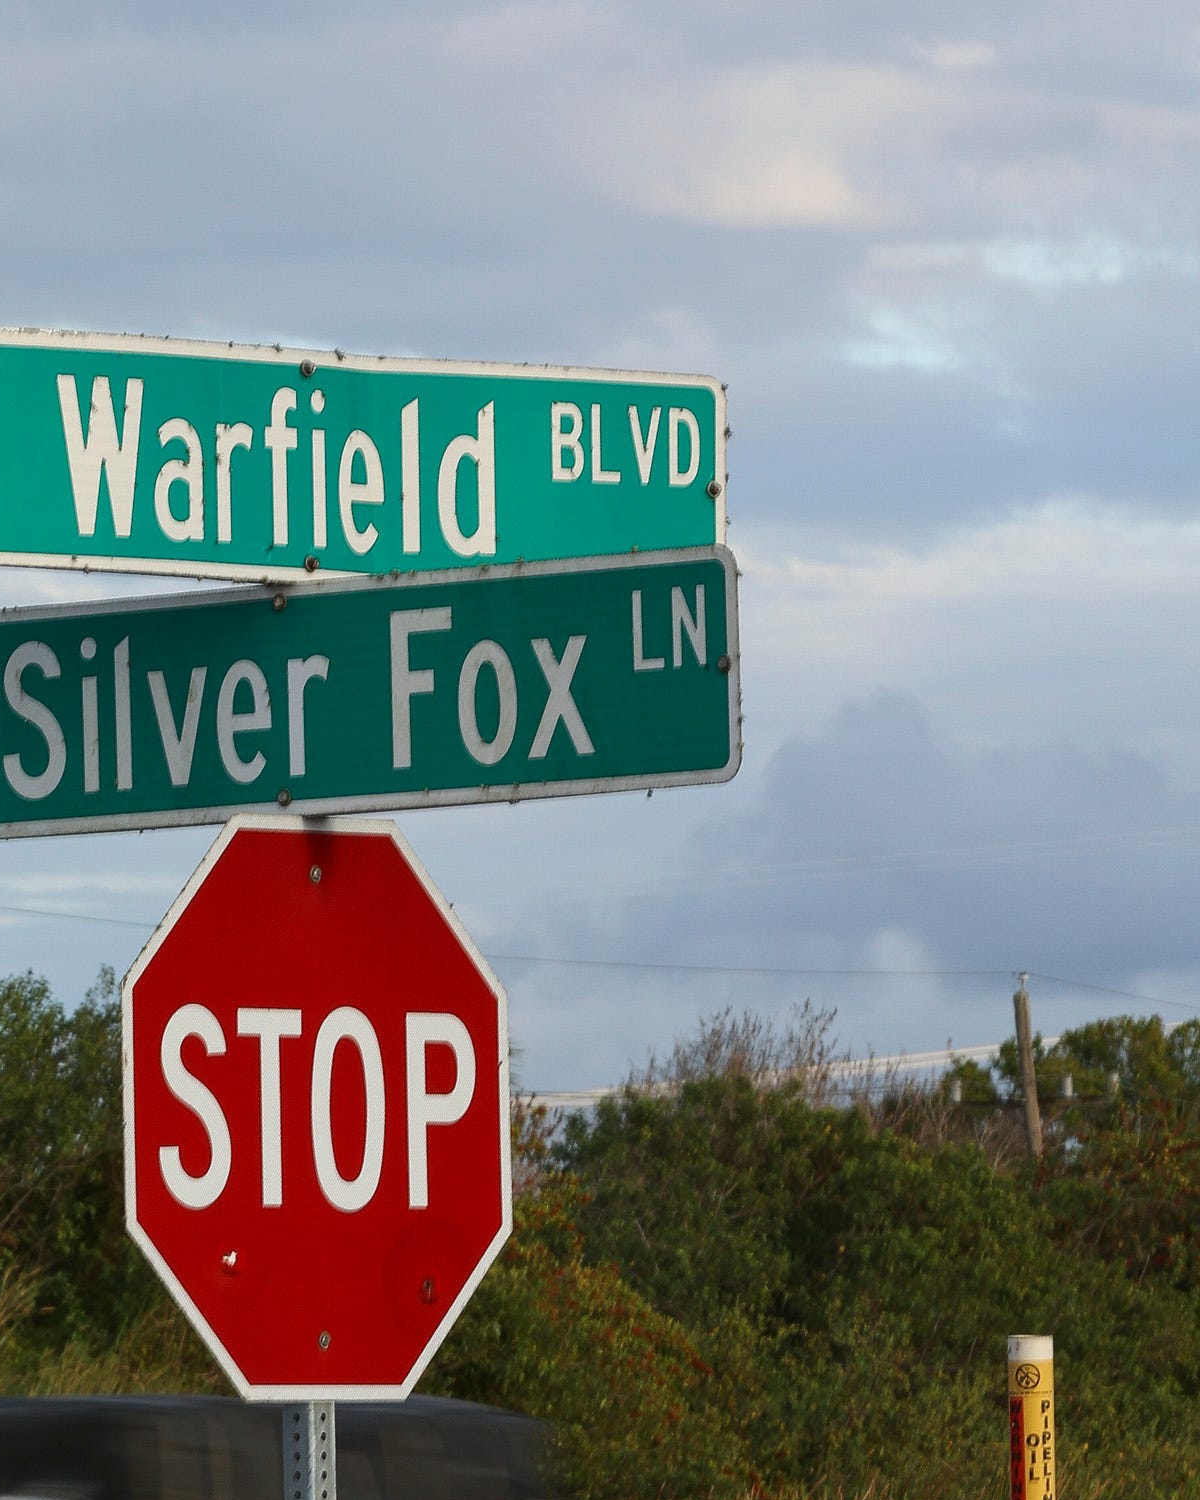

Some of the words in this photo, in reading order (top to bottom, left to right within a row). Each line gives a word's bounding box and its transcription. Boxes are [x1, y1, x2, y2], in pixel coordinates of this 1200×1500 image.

[57, 374, 497, 557] Warfield
[551, 401, 701, 487] BLVD
[3, 635, 330, 800] Silver
[390, 606, 596, 769] Fox
[631, 584, 707, 671] LN
[159, 1003, 477, 1213] STOP
[1025, 1432, 1040, 1481] OIL
